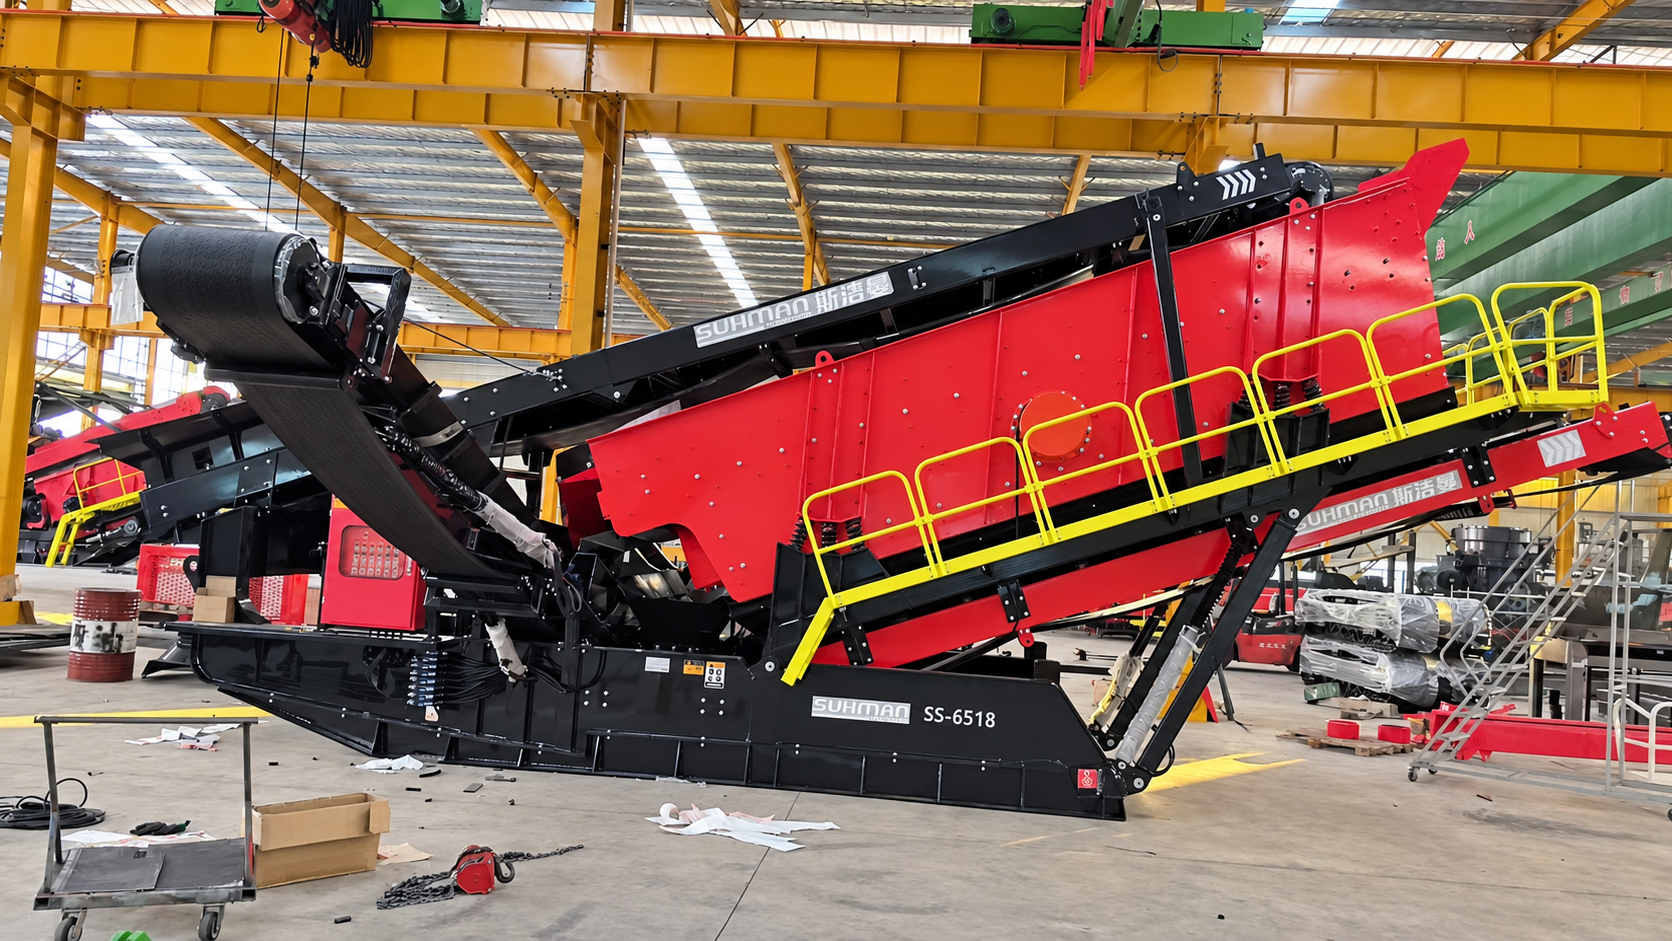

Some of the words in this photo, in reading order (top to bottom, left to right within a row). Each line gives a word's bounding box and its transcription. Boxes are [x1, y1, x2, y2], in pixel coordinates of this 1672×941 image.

[696, 297, 810, 340] SUHMAN
[813, 698, 909, 718] SUHMAN
[923, 706, 996, 728] SS-6518
